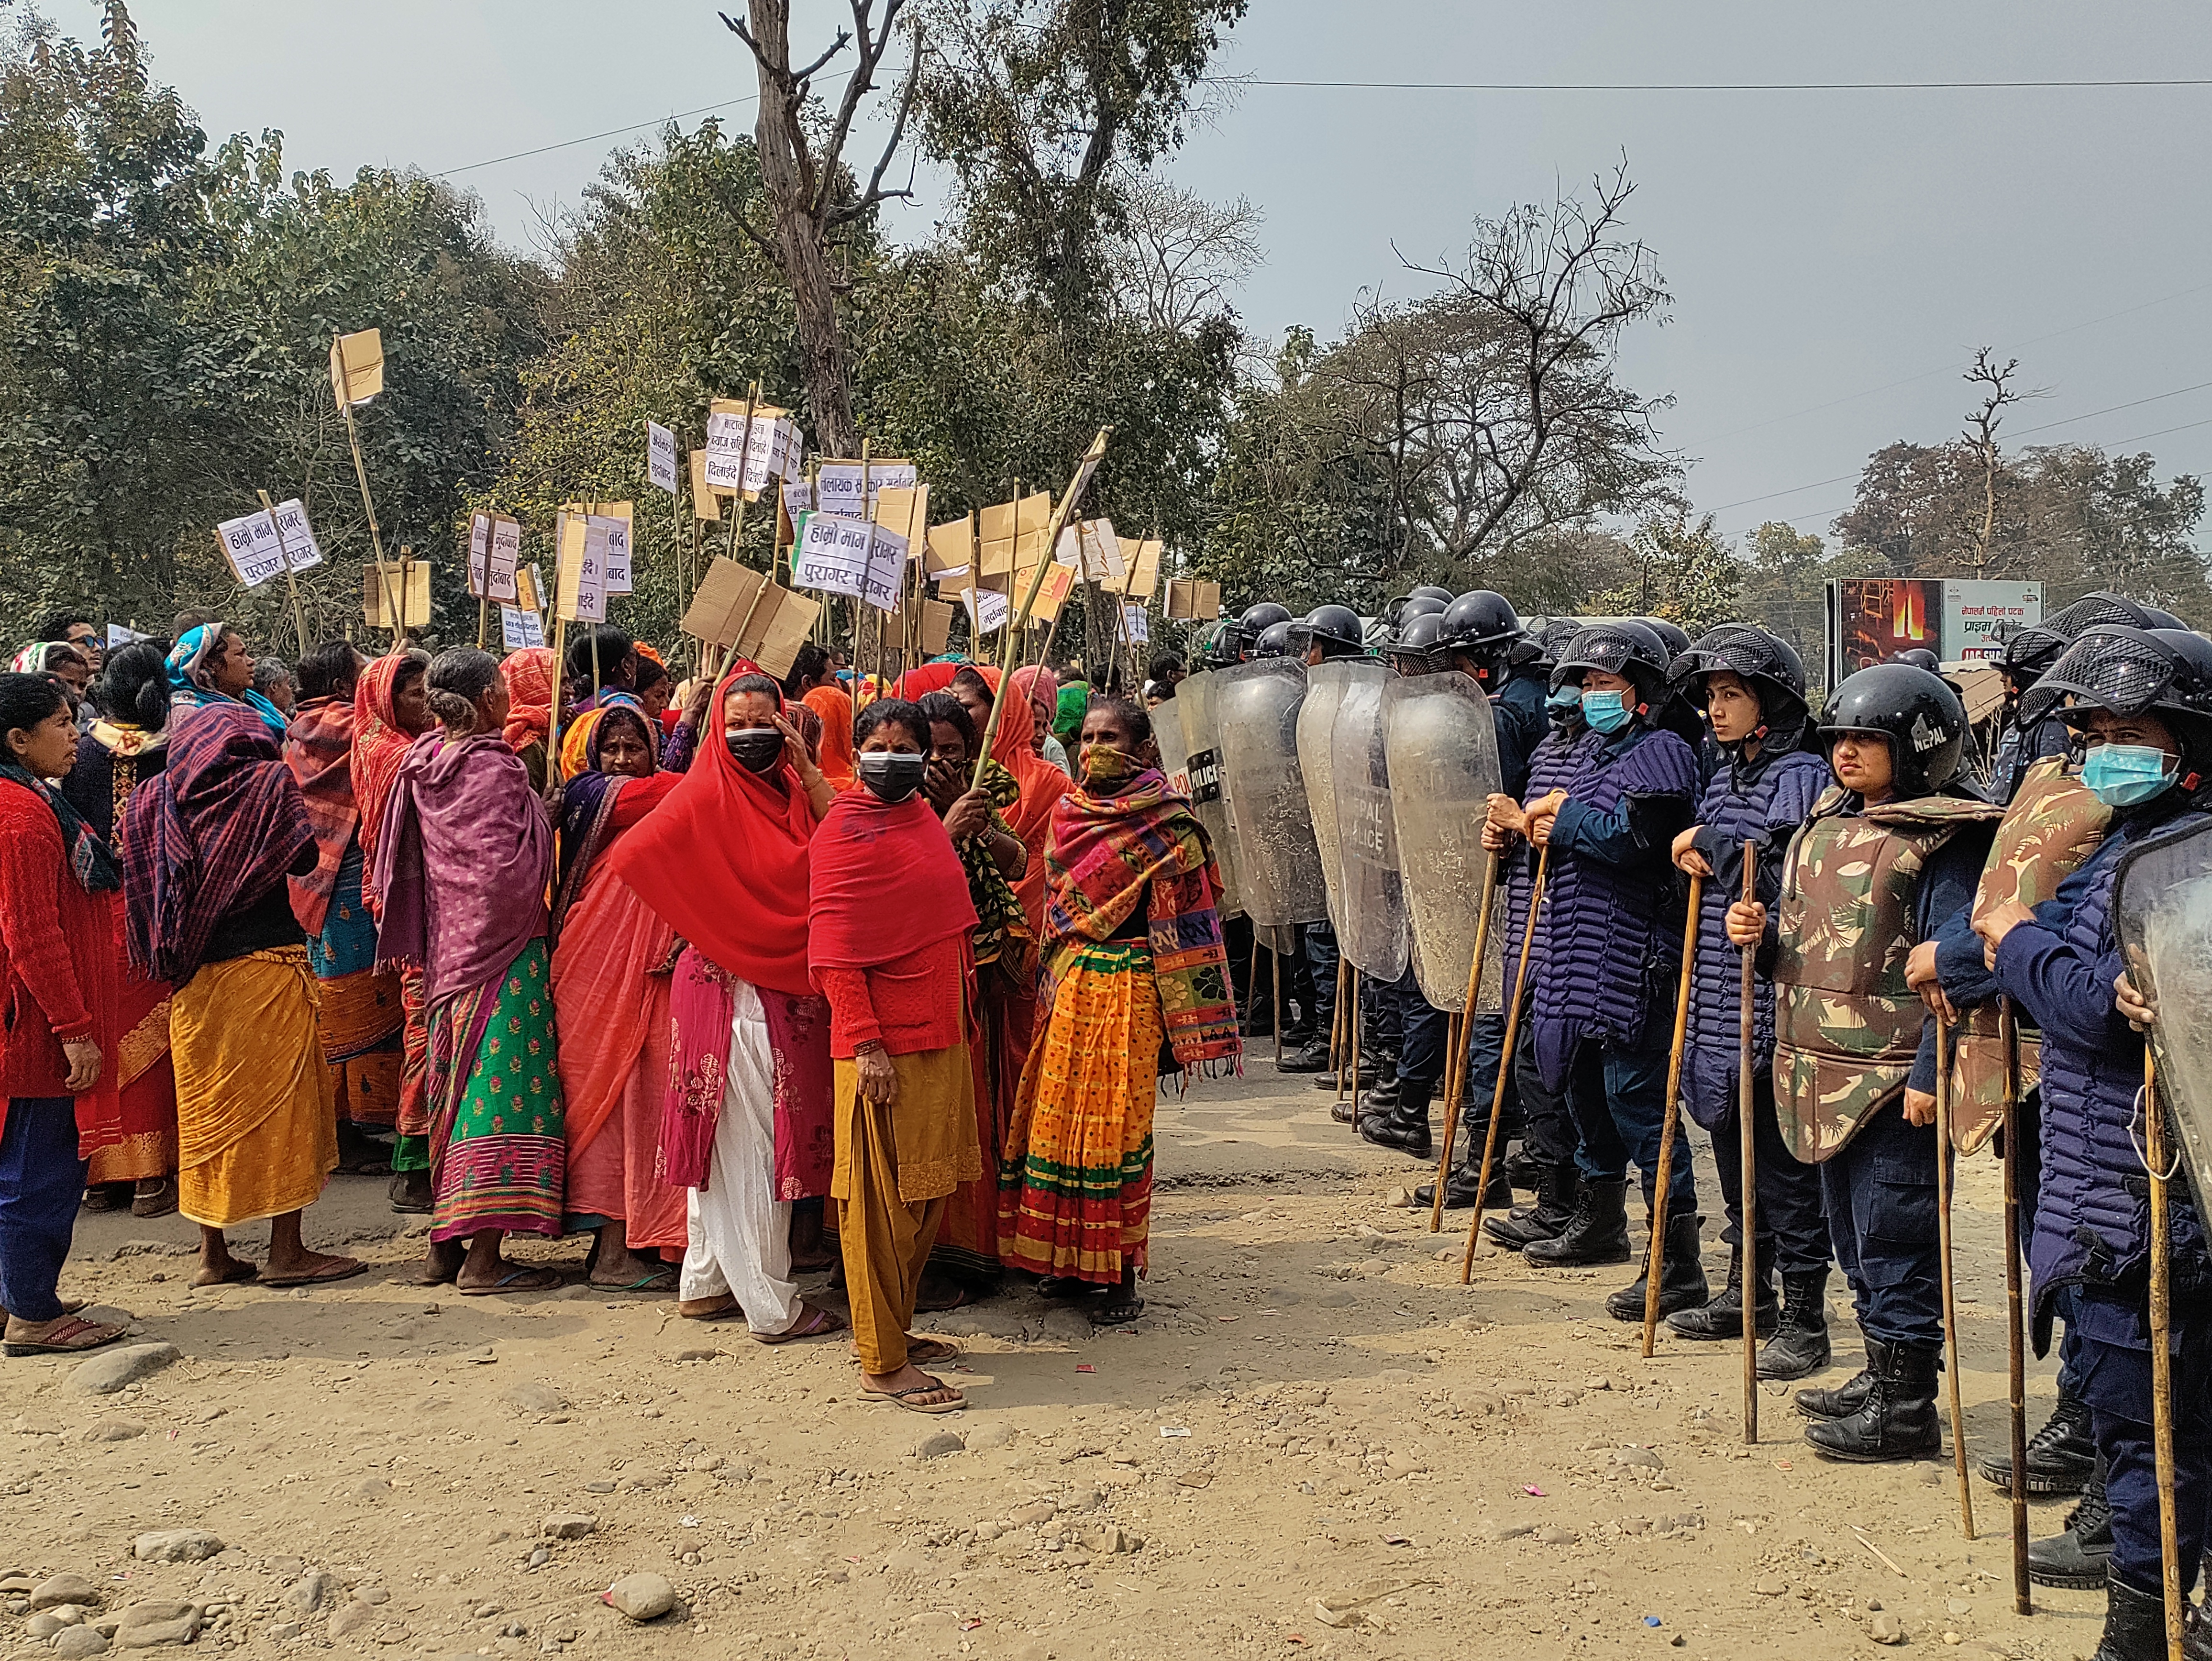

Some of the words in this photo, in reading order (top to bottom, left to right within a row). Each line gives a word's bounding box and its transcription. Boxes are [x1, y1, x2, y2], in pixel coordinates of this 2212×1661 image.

[730, 436, 743, 450] सहि
[854, 478, 884, 493] सकार
[811, 521, 840, 546] हाम्रो
[841, 529, 867, 550] माग
[805, 563, 852, 585] पुरागर
[1987, 605, 2006, 616] पहिलो
[1964, 621, 1993, 633] प्राइम
[1983, 650, 2001, 660] SHA
[1913, 726, 1947, 752] NEPAL
[1174, 773, 1192, 795] POL
[1191, 764, 1218, 790] POLICE
